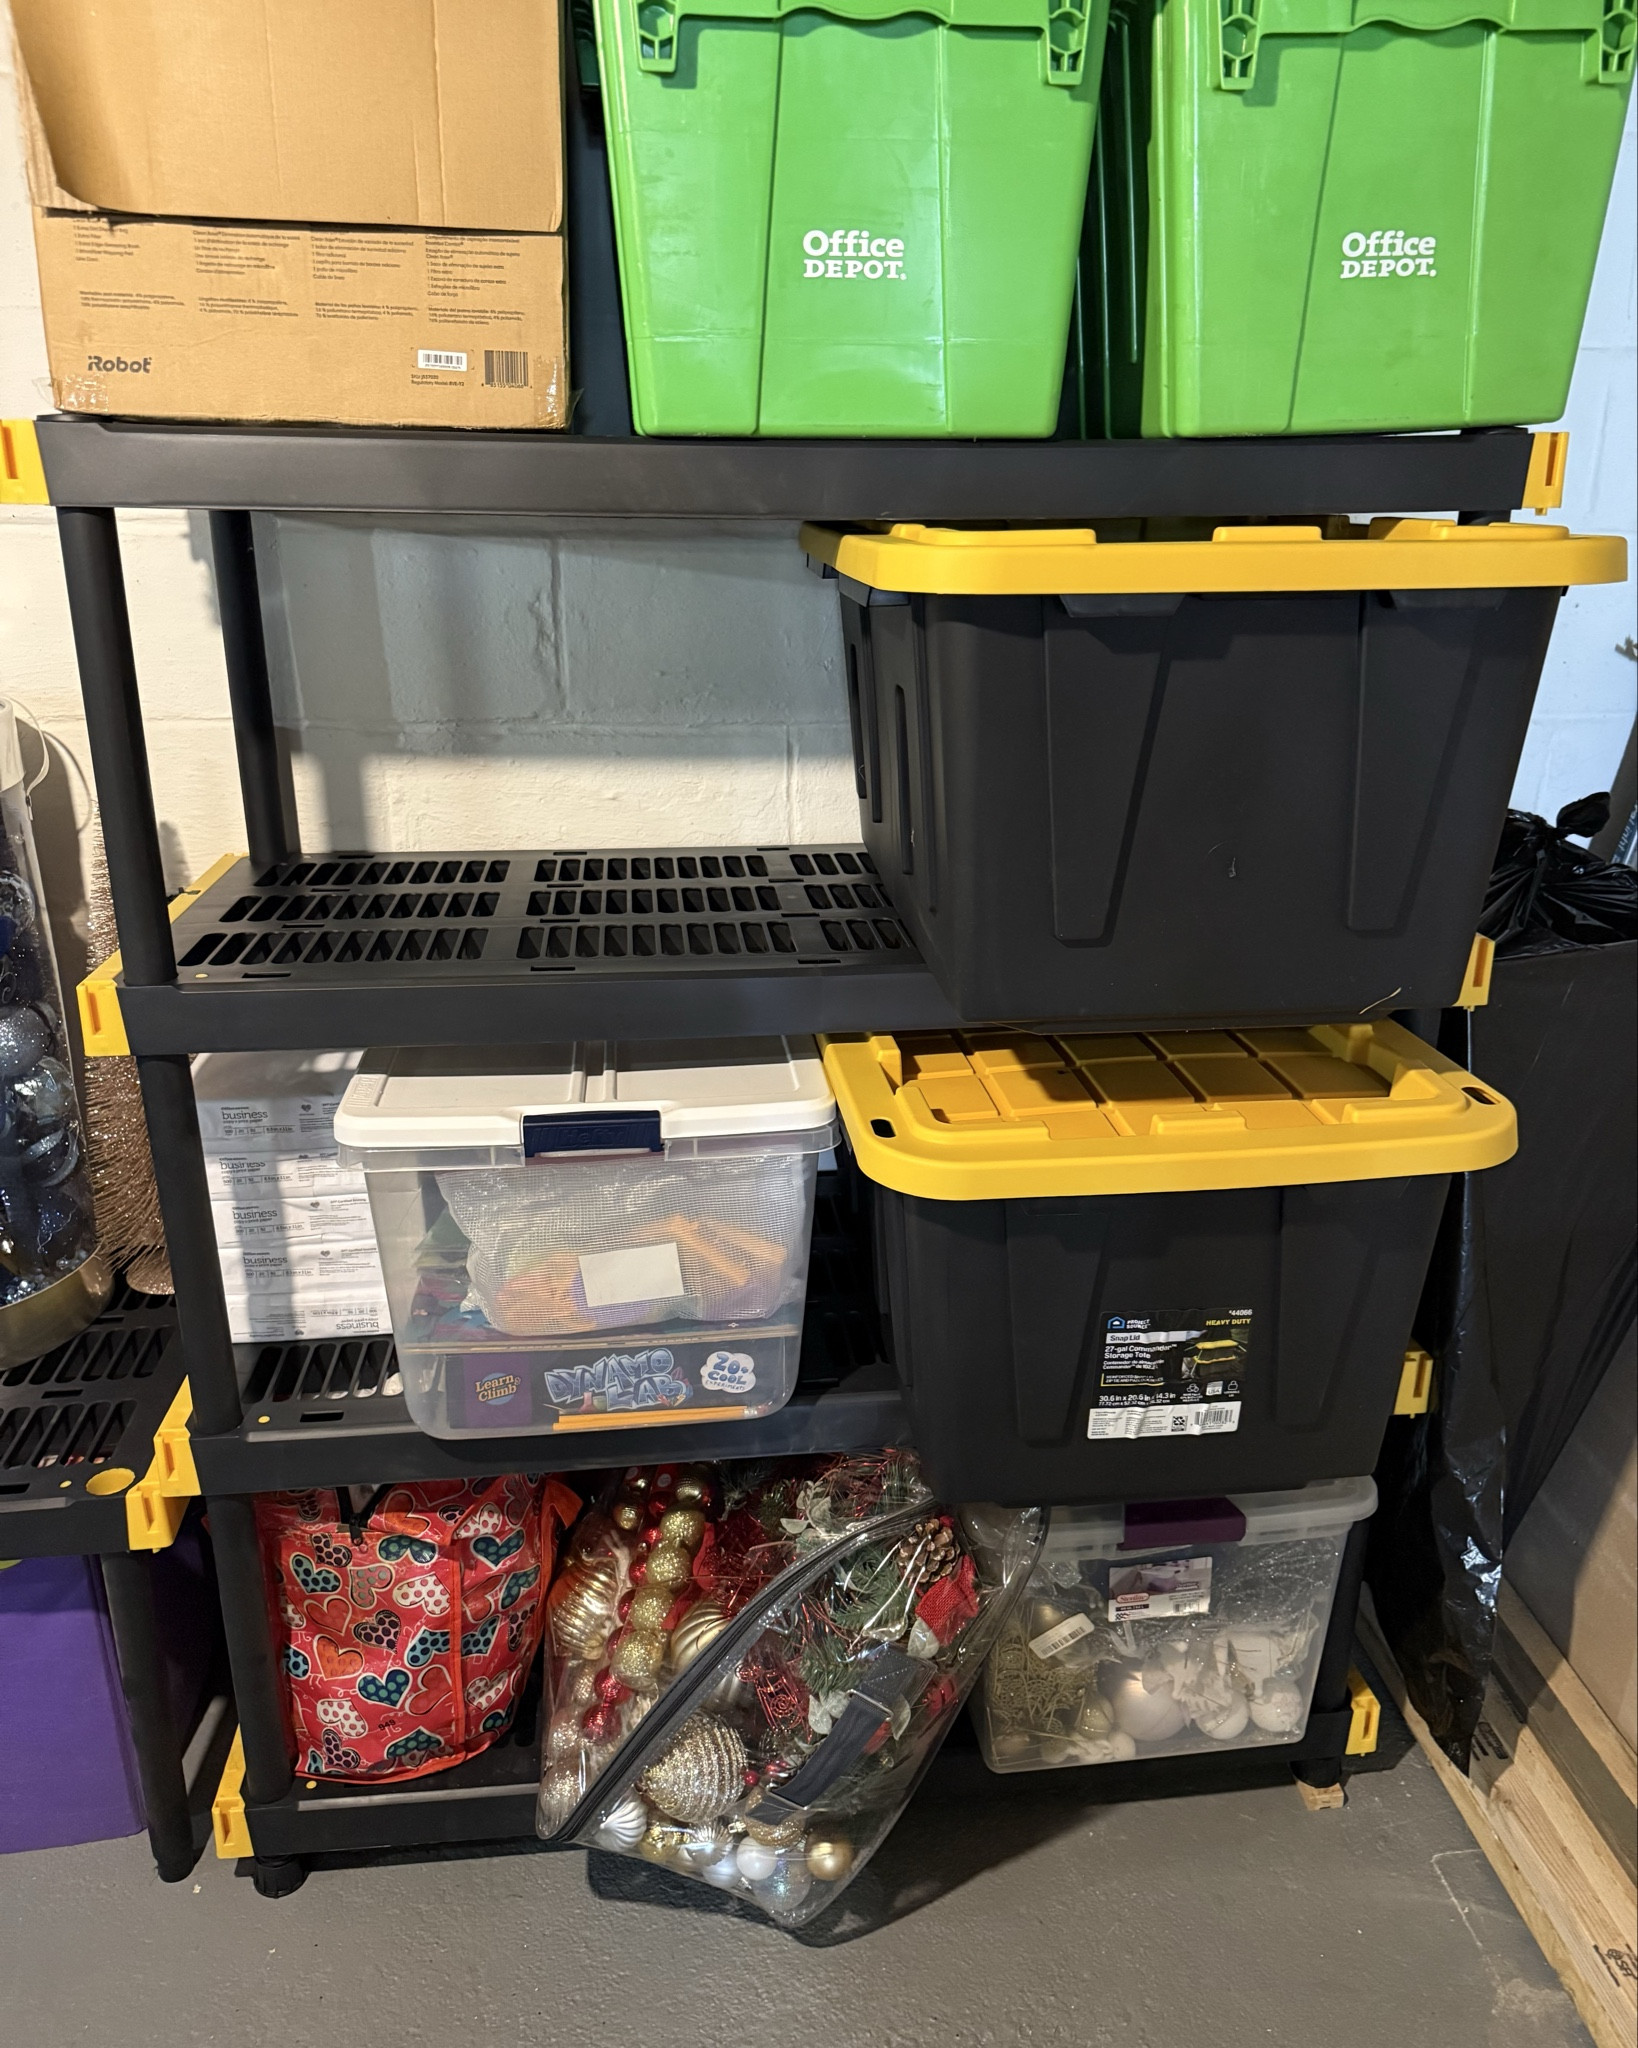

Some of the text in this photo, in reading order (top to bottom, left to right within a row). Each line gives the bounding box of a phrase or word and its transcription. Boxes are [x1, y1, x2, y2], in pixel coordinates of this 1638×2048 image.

[803, 230, 904, 257] Office
[1342, 230, 1436, 258] Office
[222, 1110, 268, 1120] business
[232, 1210, 278, 1220] business
[243, 1256, 288, 1264] business
[336, 1321, 379, 1330] business
[475, 1375, 514, 1392] Learn
[544, 1348, 674, 1404] DYNAMO
[708, 1371, 746, 1385] COOL
[478, 1384, 517, 1402] Climb
[606, 1374, 686, 1411] LAB
